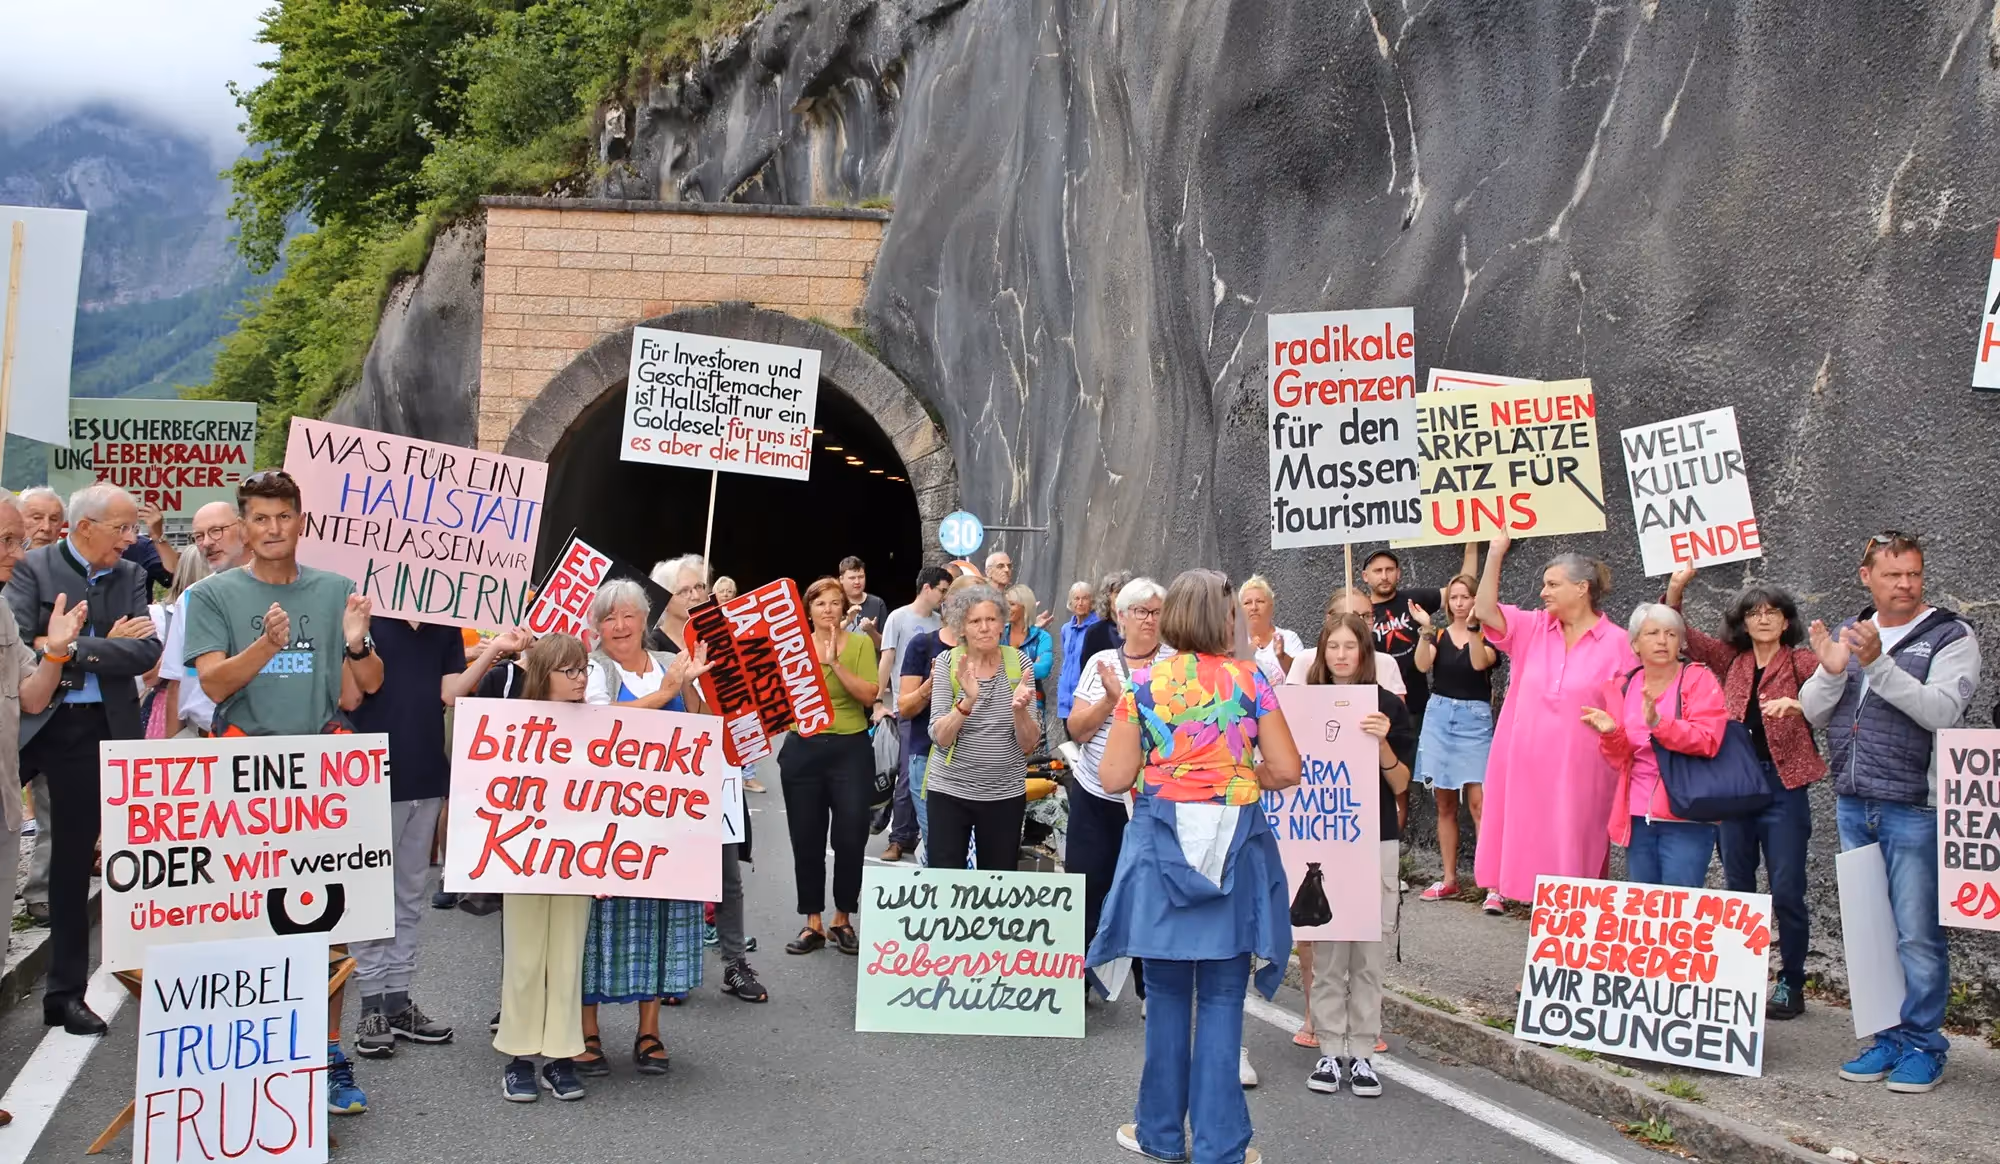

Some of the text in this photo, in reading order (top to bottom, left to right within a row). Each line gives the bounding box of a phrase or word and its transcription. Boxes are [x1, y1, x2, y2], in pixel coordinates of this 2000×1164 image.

[640, 338, 802, 380] Für Investoren und
[1274, 322, 1414, 366] radikale
[637, 361, 803, 402] Geschäftemacher
[1273, 368, 1415, 408] Grenzen
[635, 384, 806, 425] ist Hallstatt nur ein
[1416, 393, 1596, 433] EINE NEUEN
[727, 417, 751, 442] für
[757, 429, 785, 445] uns
[790, 427, 814, 448] ist
[1272, 407, 1399, 450] für den
[1417, 422, 1590, 461] ARKPLÄTZE
[1623, 419, 1717, 463] WELT-
[55, 442, 247, 470] UNG LEBENSRAUM
[305, 428, 525, 497] WAS FÜR EIN
[630, 432, 812, 471] es aber die Heimat
[1420, 453, 1606, 514] ATZ FÜR
[1631, 450, 1746, 498] KULTUR
[340, 473, 541, 543] HALLSTATT
[1431, 492, 1537, 536] UNS
[1639, 495, 1706, 534] AM
[299, 511, 528, 572] NTERLASSEN WIR
[945, 519, 977, 549] 30
[1670, 518, 1761, 563] ENDE
[563, 543, 606, 586] ES
[362, 558, 528, 627] KINDERN
[544, 571, 595, 625] REI
[259, 652, 313, 674] EECE
[760, 581, 830, 734] TOURISMUS
[468, 714, 713, 776] bitte denkt
[727, 711, 770, 765] NEIN
[106, 755, 219, 806] JETZT
[232, 752, 307, 793] EINE
[1301, 755, 1351, 785] ÄRM
[127, 792, 347, 845] BREMSUNG
[486, 775, 548, 812] an
[564, 779, 710, 820] unsere
[1258, 787, 1361, 814] ND MÜLL
[468, 807, 669, 881] Kinder
[1289, 814, 1361, 842] NICHTS
[106, 841, 392, 893] ODER wir werden
[130, 890, 264, 930] überrollt
[872, 870, 1073, 912] wir müssen
[898, 915, 1056, 946] unseren
[1531, 907, 1715, 953] FÜR BILLIGE
[1536, 882, 1771, 955] KEINE ZEIT MEHR
[866, 940, 1086, 980] Lebensraum
[1532, 937, 1719, 984] AUSREDEN
[154, 957, 304, 1012] WIRBEL
[886, 976, 1062, 1015] schützen
[1528, 964, 1757, 1027] WIR BRAUCHEN
[145, 1008, 311, 1079] TRUBEL
[1521, 1000, 1759, 1067] LÖSUNGEN
[144, 1065, 328, 1164] FRUST
